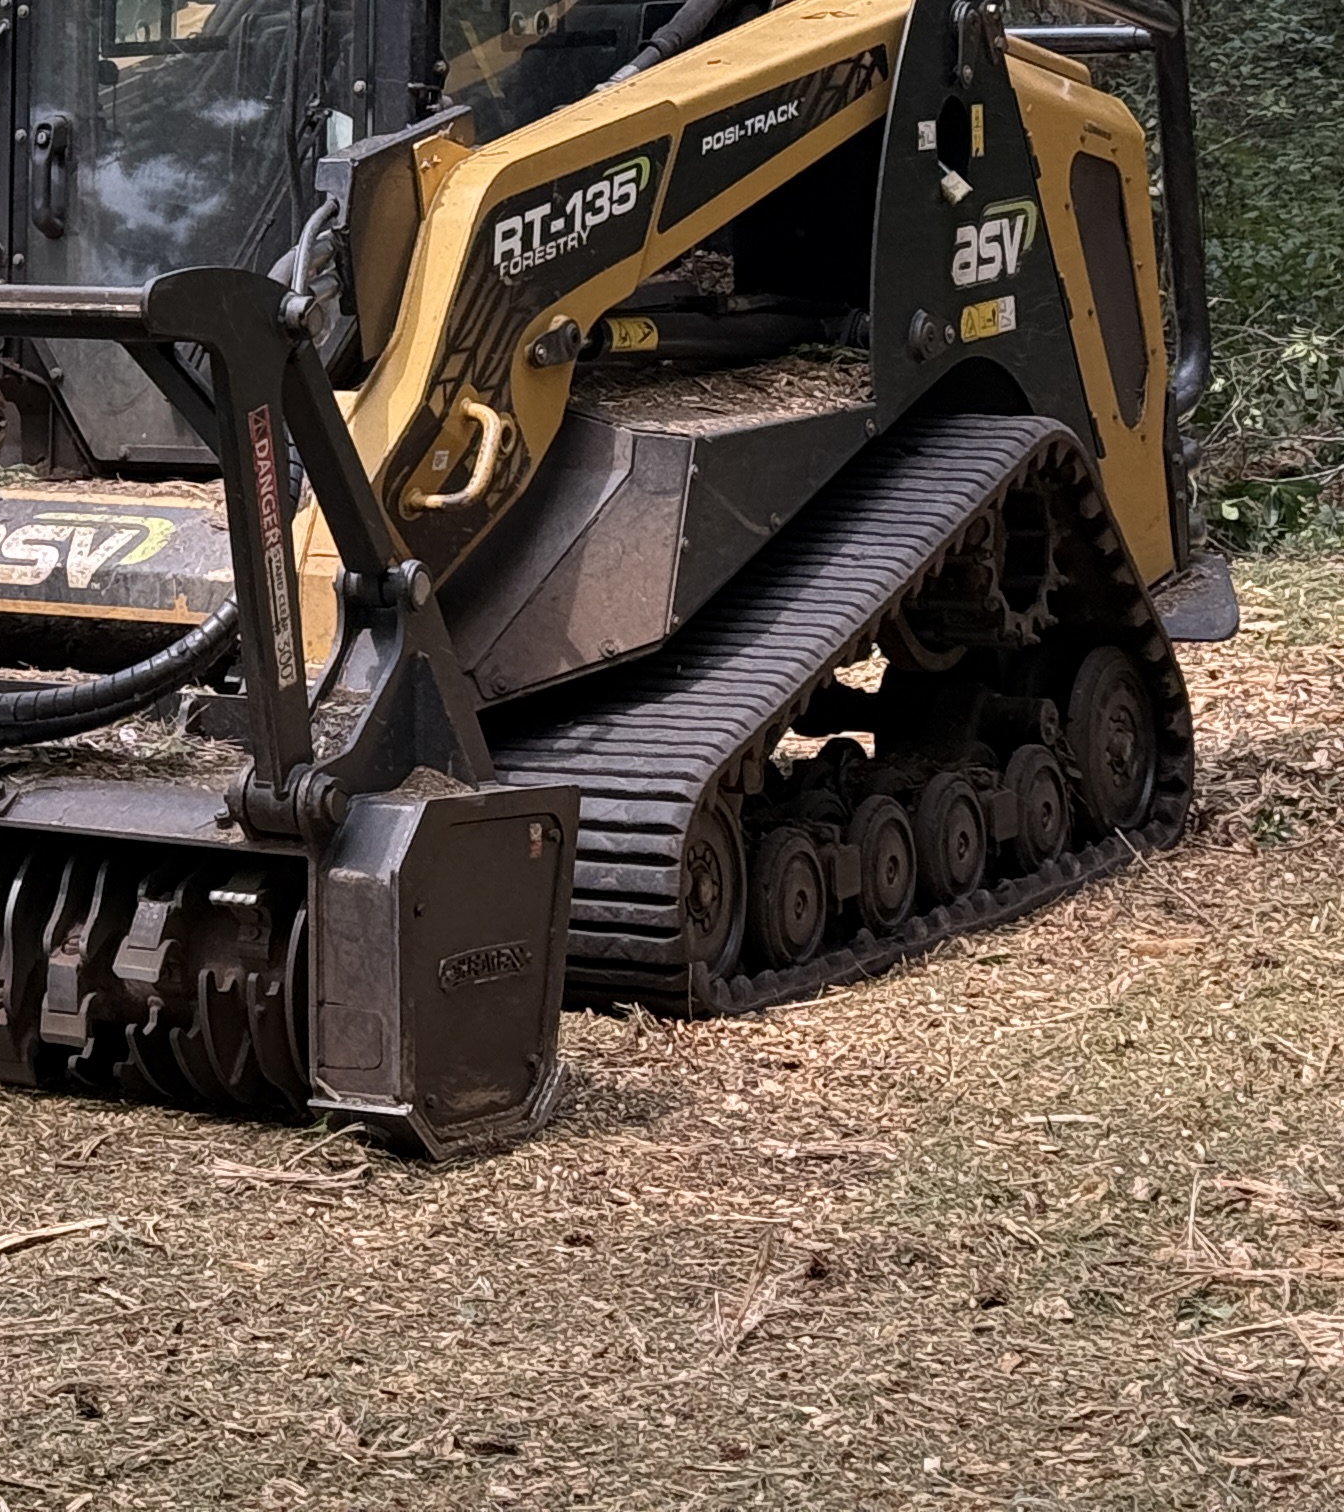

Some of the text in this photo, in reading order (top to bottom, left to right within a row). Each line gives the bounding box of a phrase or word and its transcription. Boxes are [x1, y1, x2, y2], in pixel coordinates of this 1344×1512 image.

[701, 99, 800, 156] POSI-TRACK
[493, 167, 638, 266] RT-135
[499, 225, 591, 280] FORESTRY
[255, 438, 282, 548] DANGER
[272, 548, 285, 592] STAND
[278, 593, 291, 632] CLEAR
